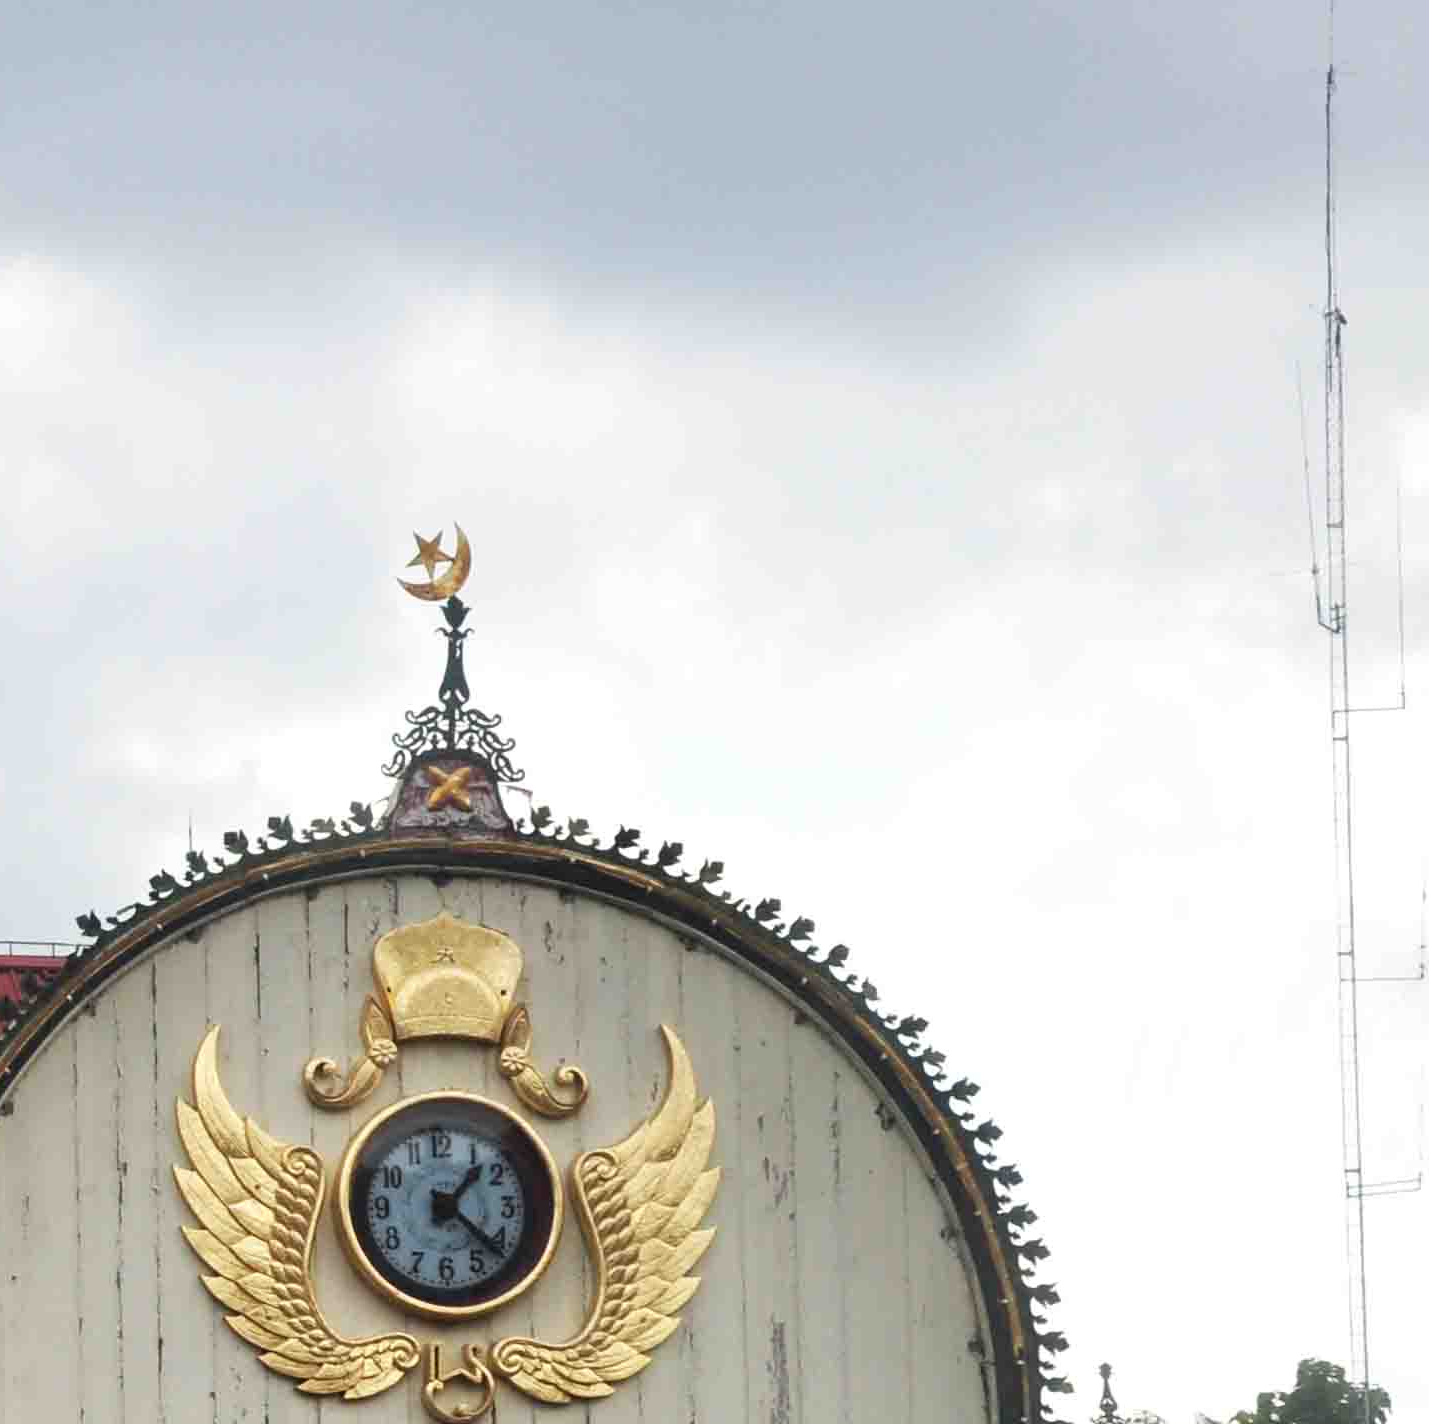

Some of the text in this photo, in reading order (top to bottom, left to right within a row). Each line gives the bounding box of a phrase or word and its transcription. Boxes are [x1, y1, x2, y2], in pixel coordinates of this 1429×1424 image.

[408, 1140, 421, 1165] 11
[431, 1134, 452, 1158] 12
[470, 1145, 477, 1165] 1
[383, 1165, 402, 1189] 10
[489, 1164, 504, 1185] 2
[374, 1196, 390, 1219] 9
[501, 1196, 515, 1218] 3
[385, 1226, 400, 1250] 8
[491, 1225, 507, 1251] 4
[411, 1251, 425, 1275] 7
[438, 1256, 454, 1281] 6
[469, 1250, 484, 1273] 5
